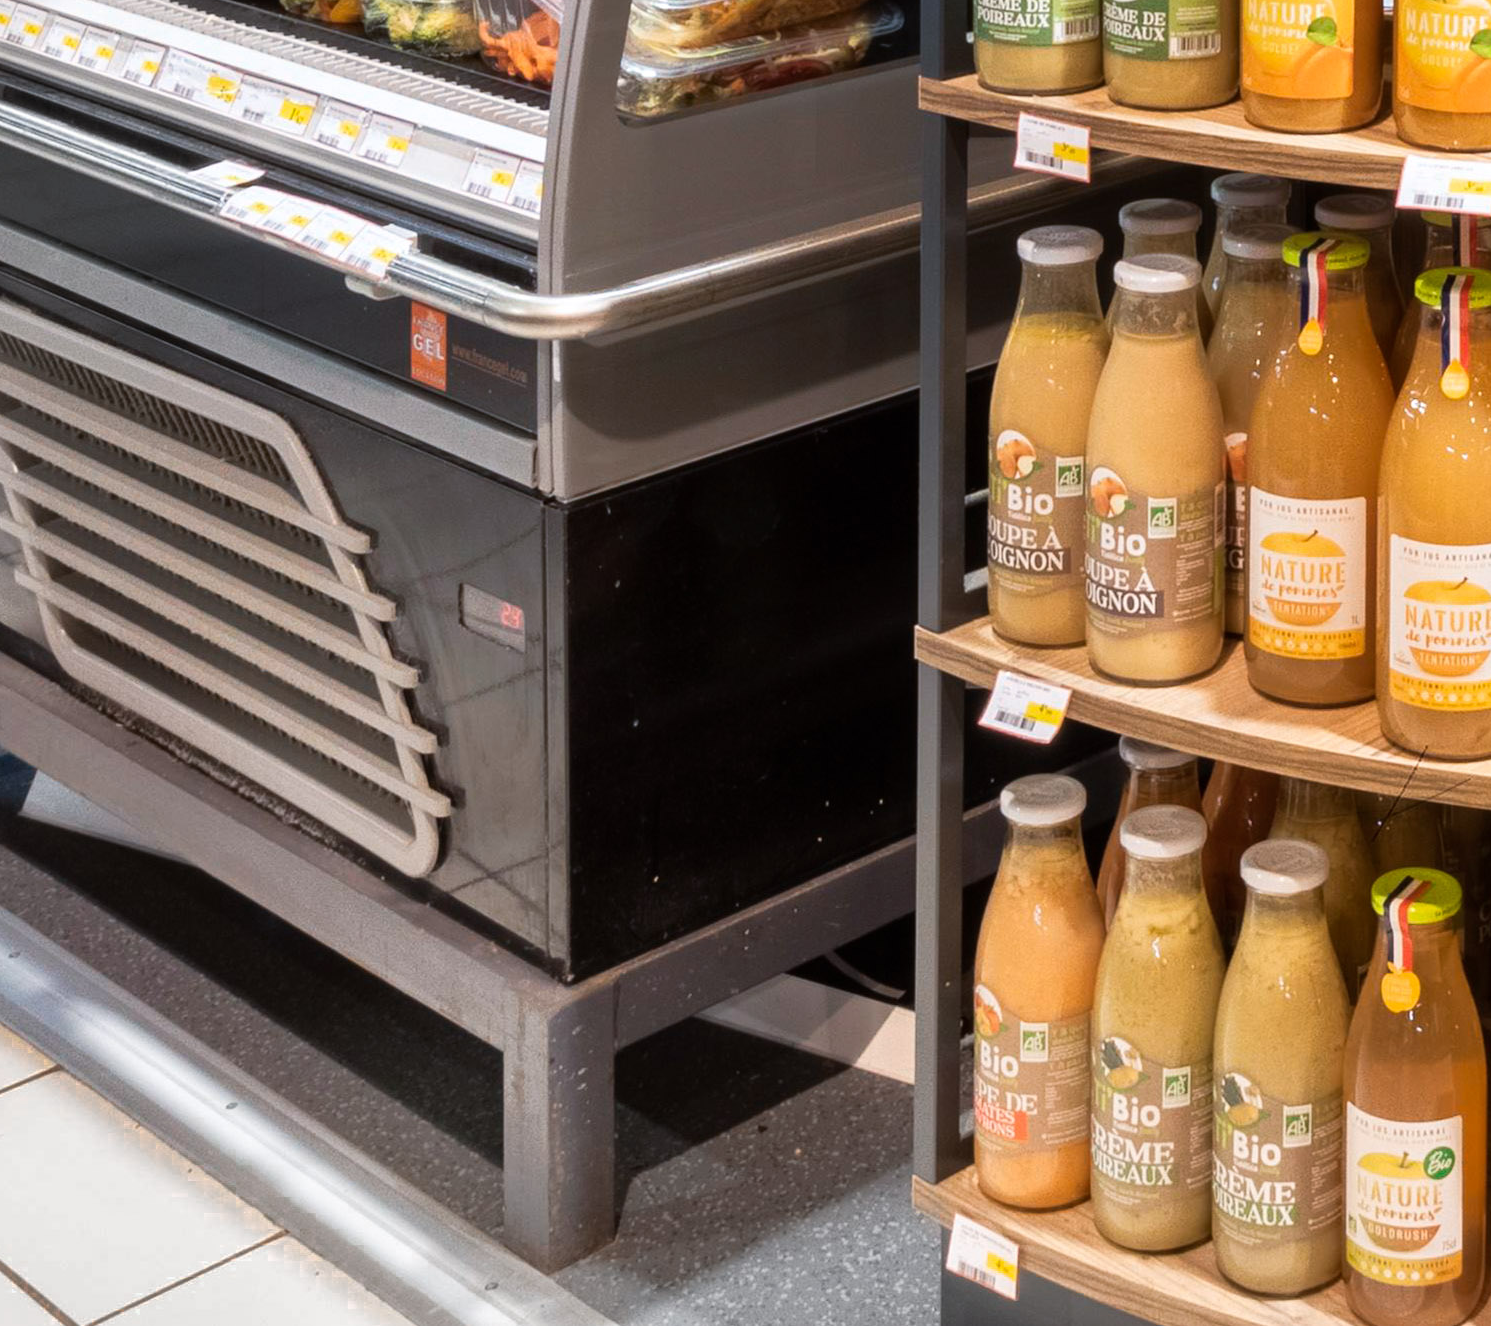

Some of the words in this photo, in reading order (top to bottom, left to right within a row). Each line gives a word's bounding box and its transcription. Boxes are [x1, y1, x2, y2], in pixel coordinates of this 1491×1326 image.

[977, 9, 1050, 28] POIREAUX
[413, 333, 444, 360] GEL
[1007, 483, 1054, 515] Bio
[1043, 526, 1062, 549] À
[1100, 523, 1146, 557] Bio
[1134, 567, 1155, 592] À
[1261, 554, 1347, 585] NATURE
[980, 1040, 1019, 1078] Bio
[1112, 1092, 1160, 1127] Bio
[1233, 1129, 1281, 1167] Bio
